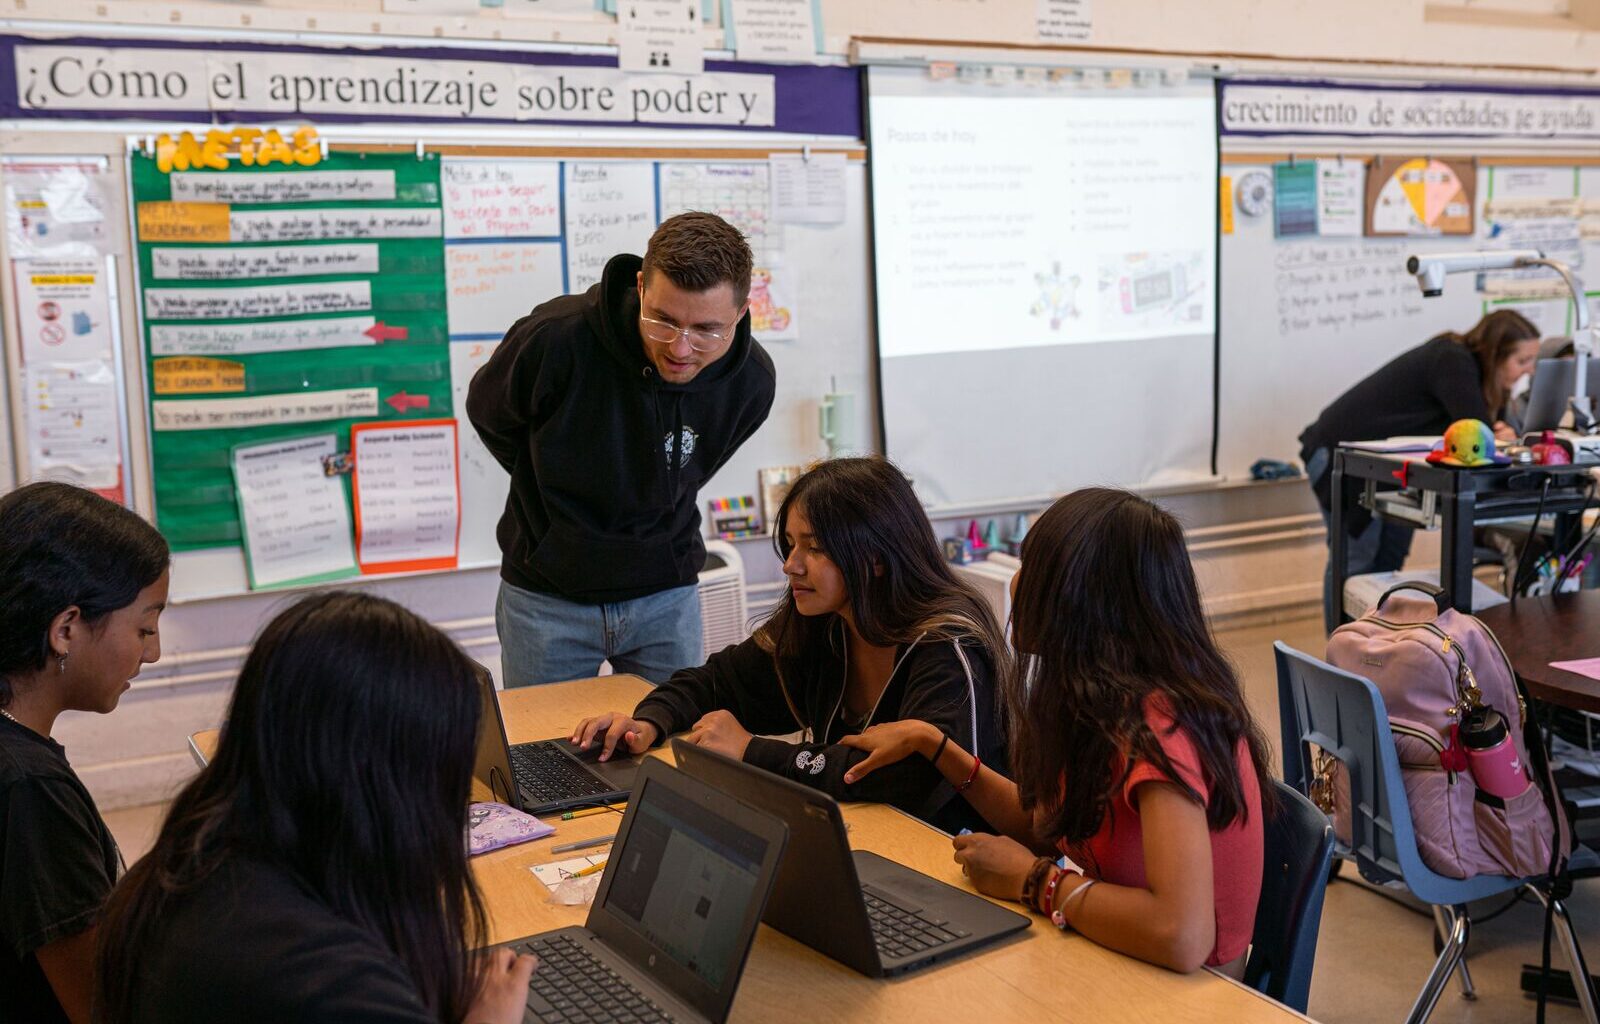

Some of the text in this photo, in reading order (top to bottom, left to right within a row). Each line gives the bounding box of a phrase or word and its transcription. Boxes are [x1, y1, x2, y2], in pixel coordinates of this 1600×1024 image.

[24, 56, 758, 126] ¿Cómo el aprendizaje sobre poder y
[1226, 93, 1358, 127] crecimiento
[1369, 101, 1395, 128] de
[1404, 98, 1510, 130] sociedades
[1538, 104, 1594, 135] ayuda
[887, 126, 977, 147] Pasos de hoy
[155, 125, 322, 173] METAS
[572, 163, 609, 181] Agenda
[507, 184, 546, 204] seguir
[579, 187, 624, 203] Lectura
[393, 433, 411, 443] Daily
[412, 432, 446, 441] Schedule
